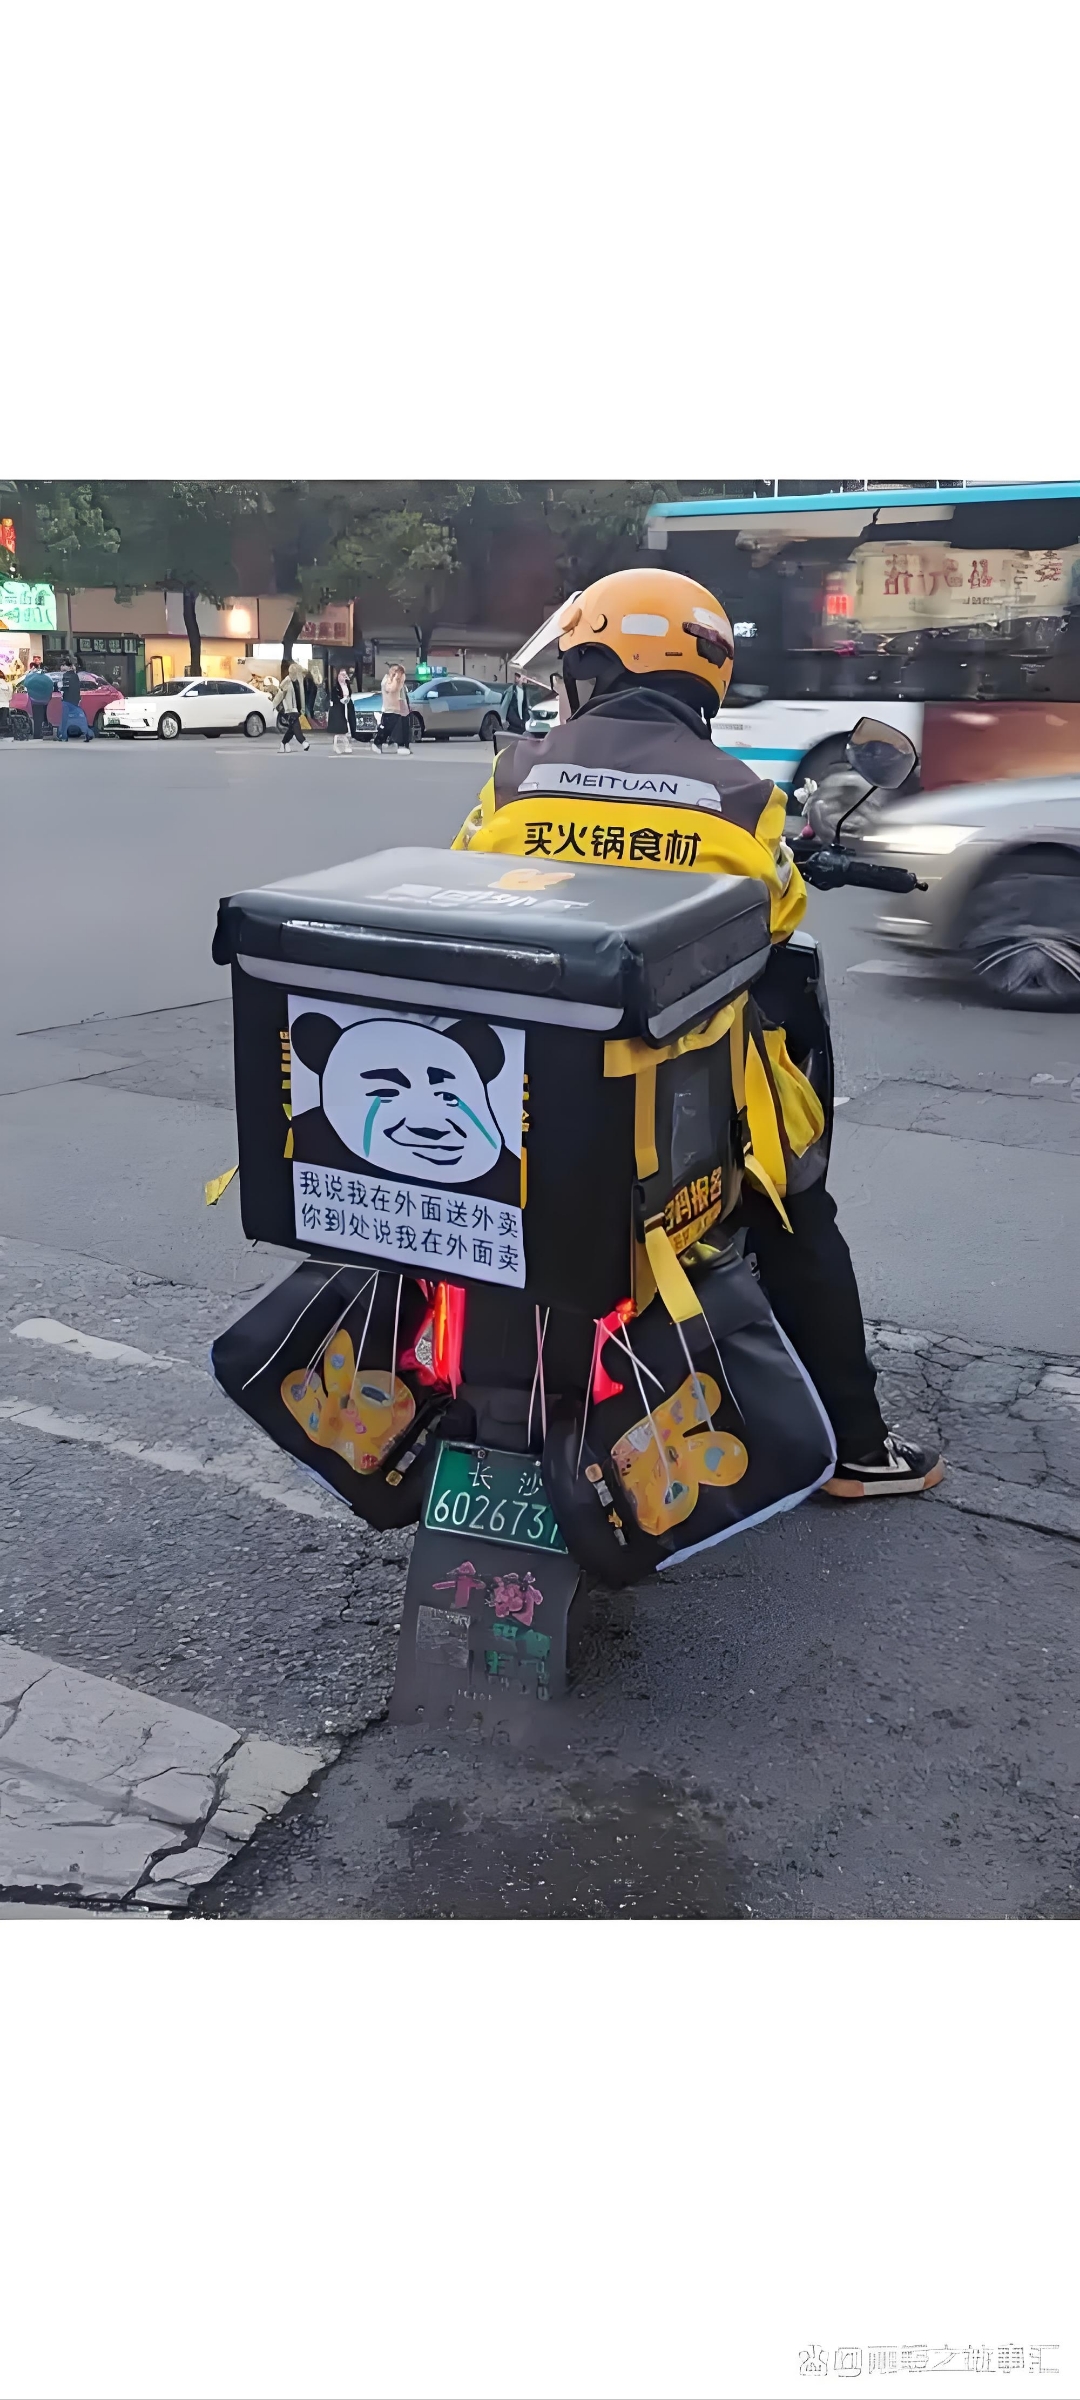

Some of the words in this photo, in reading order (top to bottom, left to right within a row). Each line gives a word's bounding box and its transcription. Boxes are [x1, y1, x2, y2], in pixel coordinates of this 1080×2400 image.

[559, 770, 678, 795] MEITUAN
[524, 821, 702, 867] 买火锅食材
[299, 1170, 518, 1238] 我说我在外面送外卖
[301, 1203, 519, 1272] 你到处说我在外面卖
